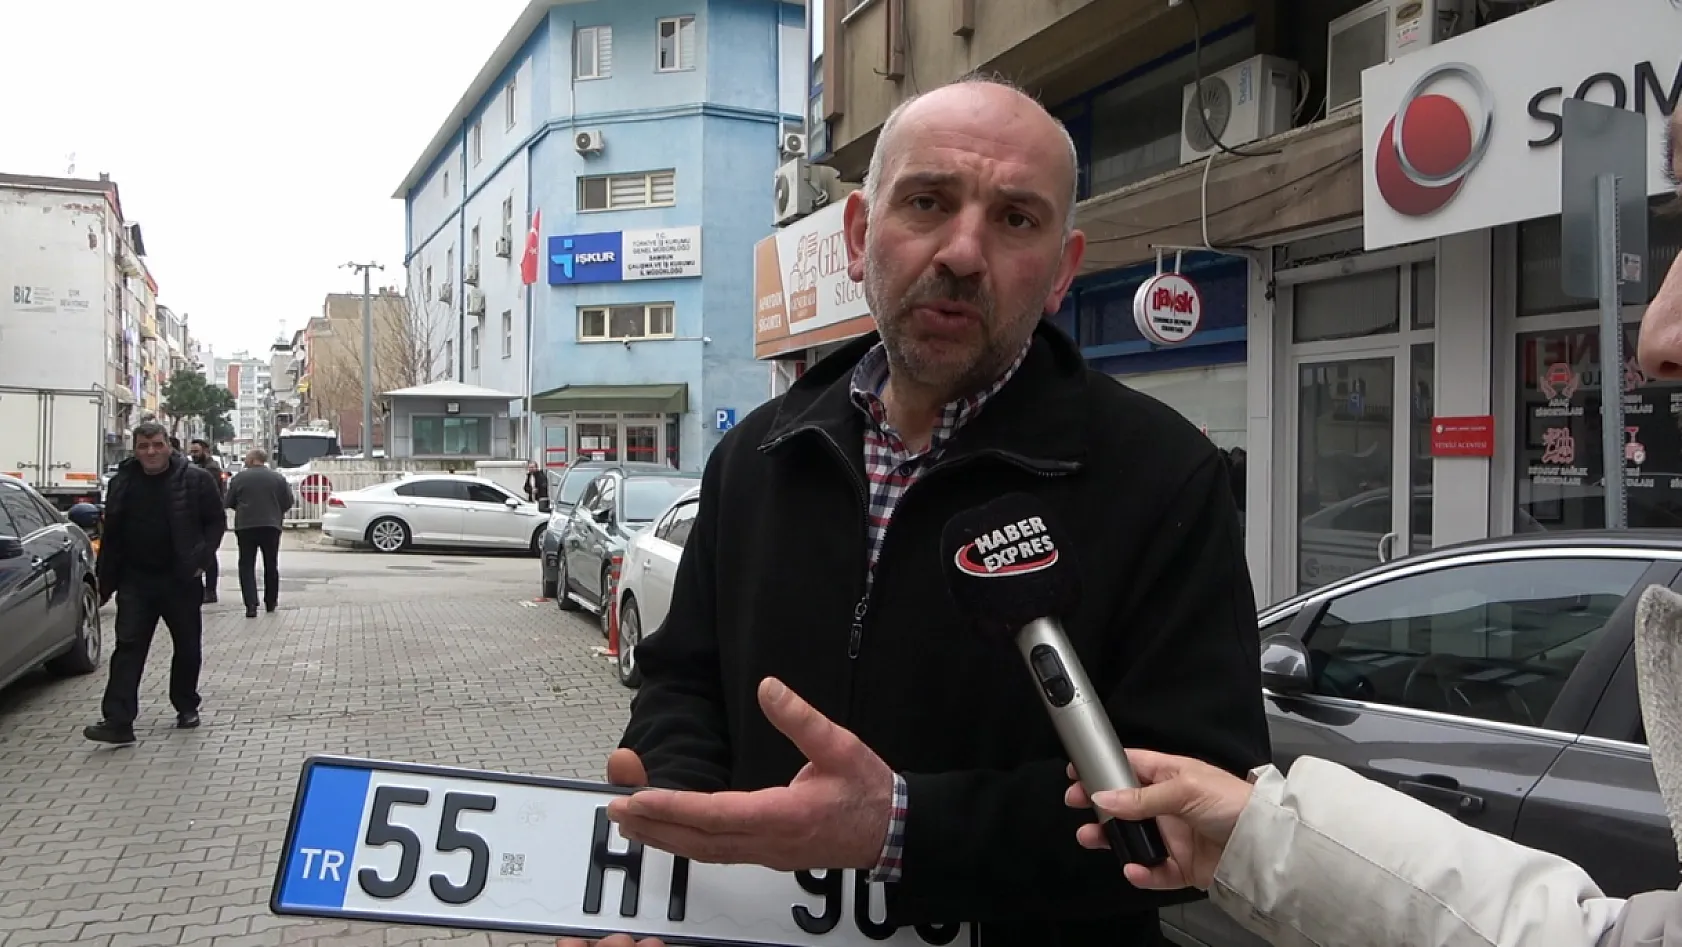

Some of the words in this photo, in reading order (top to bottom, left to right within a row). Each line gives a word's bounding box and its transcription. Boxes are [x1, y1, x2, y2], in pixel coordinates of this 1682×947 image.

[974, 516, 1047, 554] HABER
[983, 535, 1054, 572] EXPRES
[357, 785, 497, 904] 55
[300, 848, 346, 882] TR
